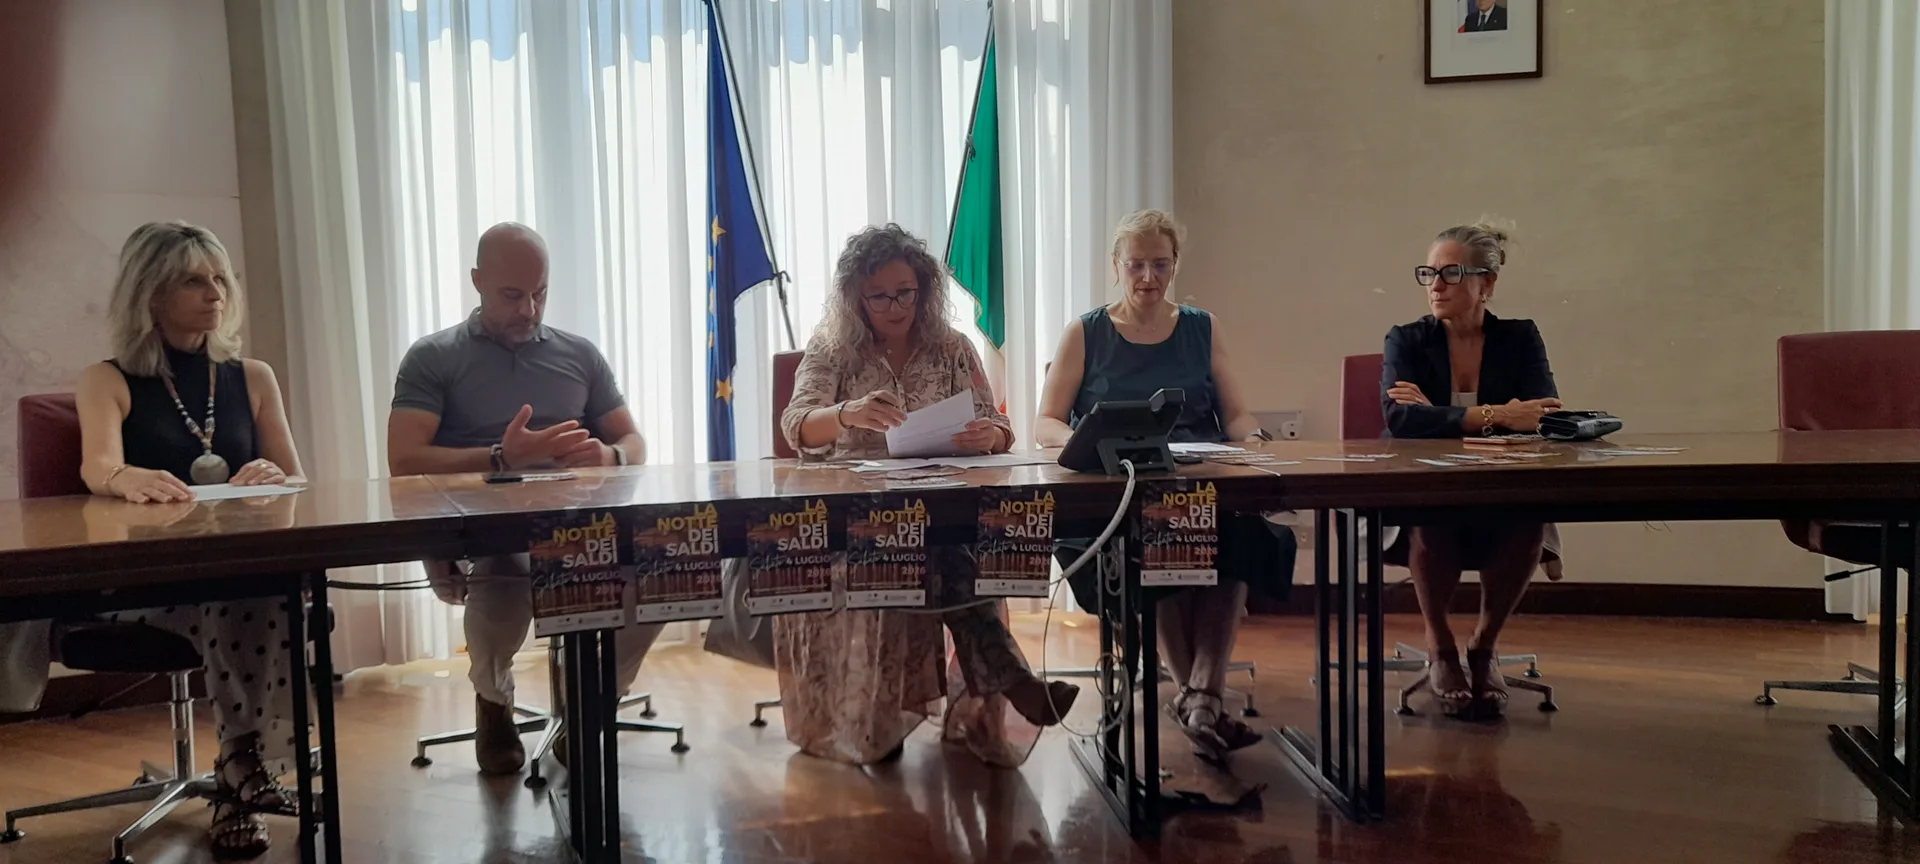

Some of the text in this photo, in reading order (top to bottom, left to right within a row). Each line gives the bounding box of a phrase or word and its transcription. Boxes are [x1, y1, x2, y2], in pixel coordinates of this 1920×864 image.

[1196, 481, 1216, 493] LA
[1034, 490, 1055, 503] LA
[1163, 493, 1217, 506] NOTTE
[694, 503, 718, 517] LA
[805, 499, 827, 512] LA
[904, 498, 926, 511] LA
[1000, 501, 1055, 515] NOTTE
[1189, 504, 1216, 517] DEI
[592, 511, 616, 525] LA
[657, 516, 718, 531] NOTTE
[769, 511, 827, 527] NOTTE
[869, 510, 926, 524] NOTTE
[1026, 512, 1053, 527] DEI
[1168, 516, 1216, 529] SALDI
[553, 525, 616, 543] NOTTE
[688, 528, 718, 542] DEI
[799, 522, 828, 537] DEI
[897, 522, 924, 535] DEI
[1004, 524, 1053, 538] SALDI
[586, 537, 617, 552] DEI
[778, 536, 828, 551] SALDI
[875, 534, 924, 547] SALDI
[1185, 534, 1218, 543] LUGLIO
[666, 541, 719, 556] SALDI
[1011, 543, 1018, 551] 4
[1020, 544, 1053, 552] LUGLIO
[562, 551, 618, 568] SALDI
[794, 555, 831, 565] LUGLIO
[883, 553, 889, 561] 4
[891, 553, 926, 562] LUGLIO
[684, 561, 721, 571] LUGLIO
